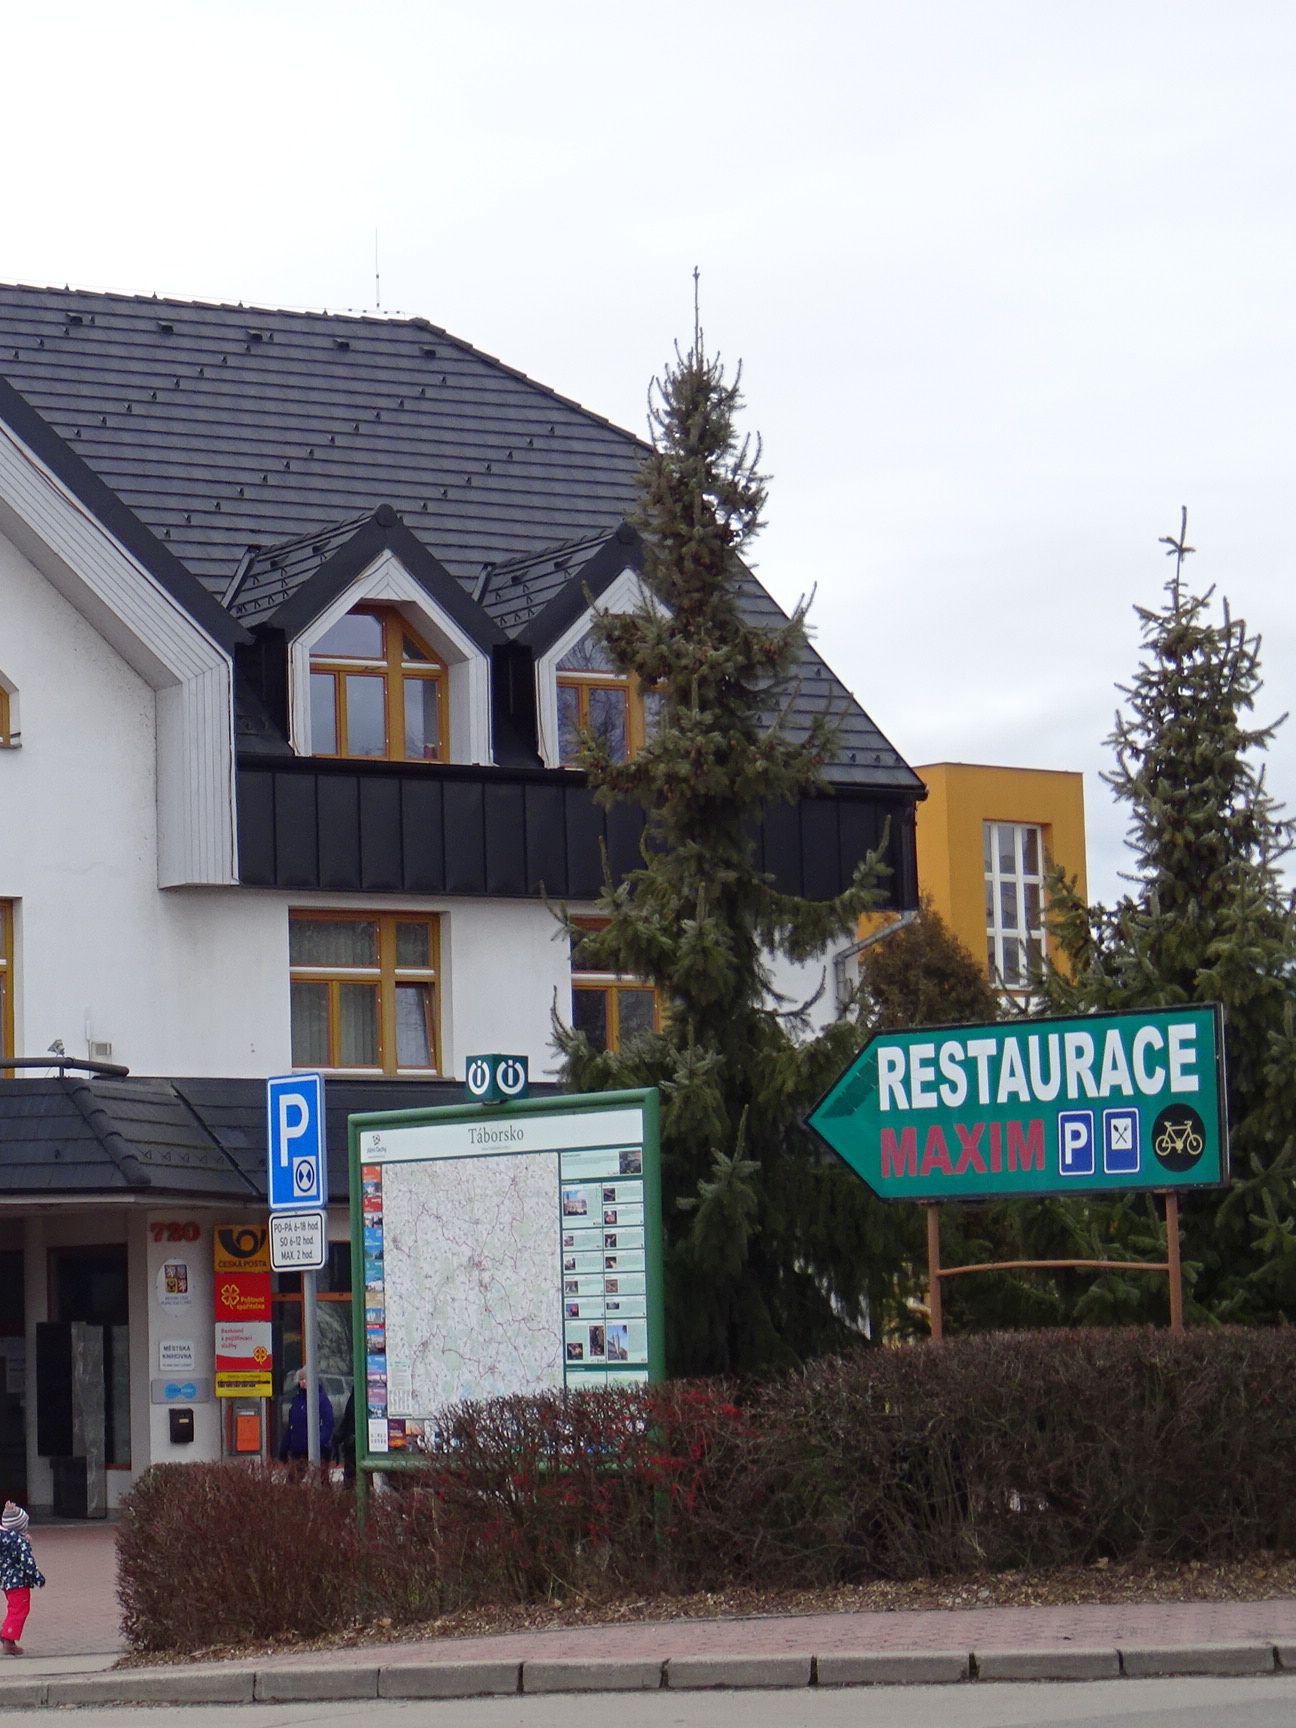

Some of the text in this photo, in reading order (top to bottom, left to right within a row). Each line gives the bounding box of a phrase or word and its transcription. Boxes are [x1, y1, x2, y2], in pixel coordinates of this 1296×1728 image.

[877, 1023, 1200, 1111] RESTAURACE
[279, 1093, 310, 1168] P
[467, 1124, 524, 1144] Táborsko
[880, 1119, 1045, 1178] MAXIM
[279, 1236, 289, 1247] SO
[296, 1250, 301, 1260] 2
